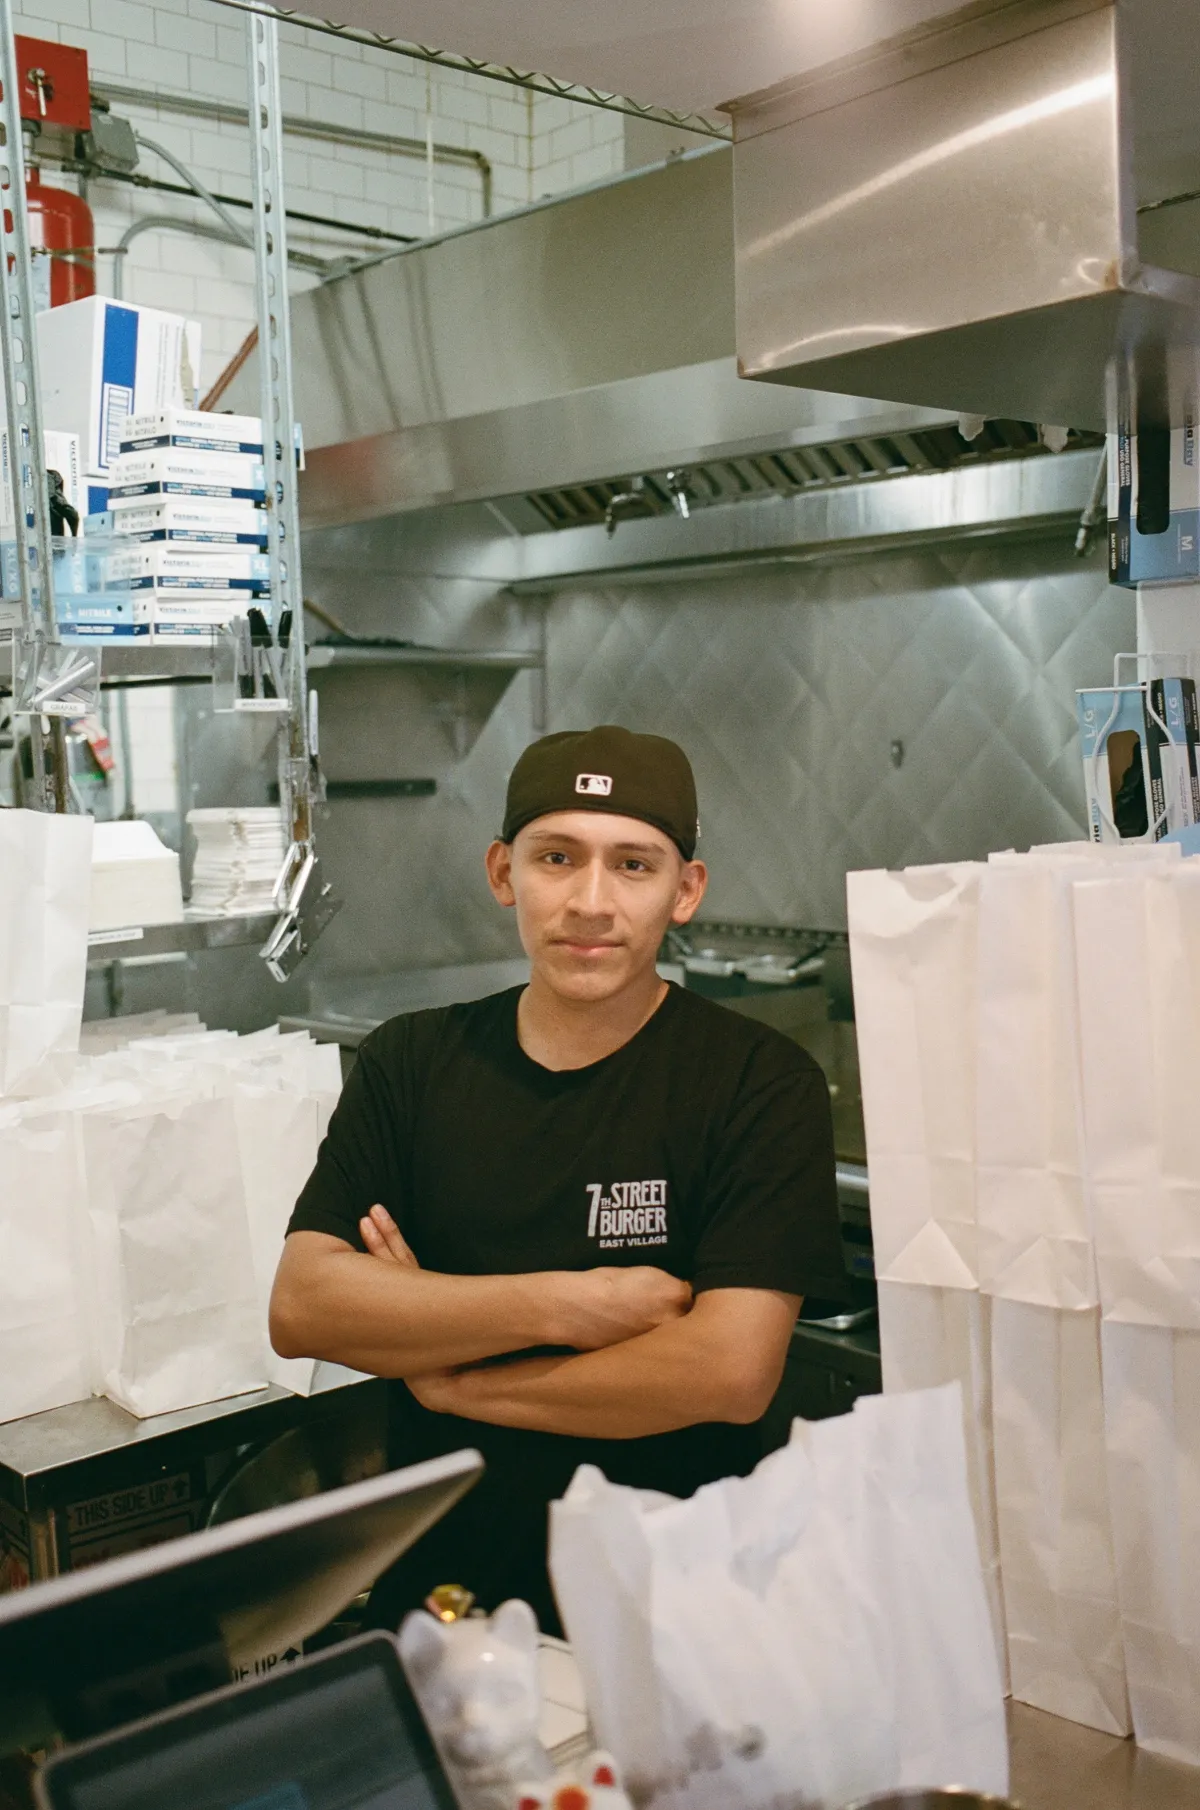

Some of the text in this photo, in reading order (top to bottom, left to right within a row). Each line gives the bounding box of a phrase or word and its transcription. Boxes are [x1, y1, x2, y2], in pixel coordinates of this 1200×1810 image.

[1181, 535, 1194, 551] M
[1083, 711, 1097, 739] L/G
[1169, 696, 1179, 726] L/G
[610, 1180, 667, 1208] STREET
[600, 1207, 667, 1236] BURGER
[599, 1235, 668, 1248] EAST VILLAGE
[75, 1483, 170, 1526] THIS SIDE UP
